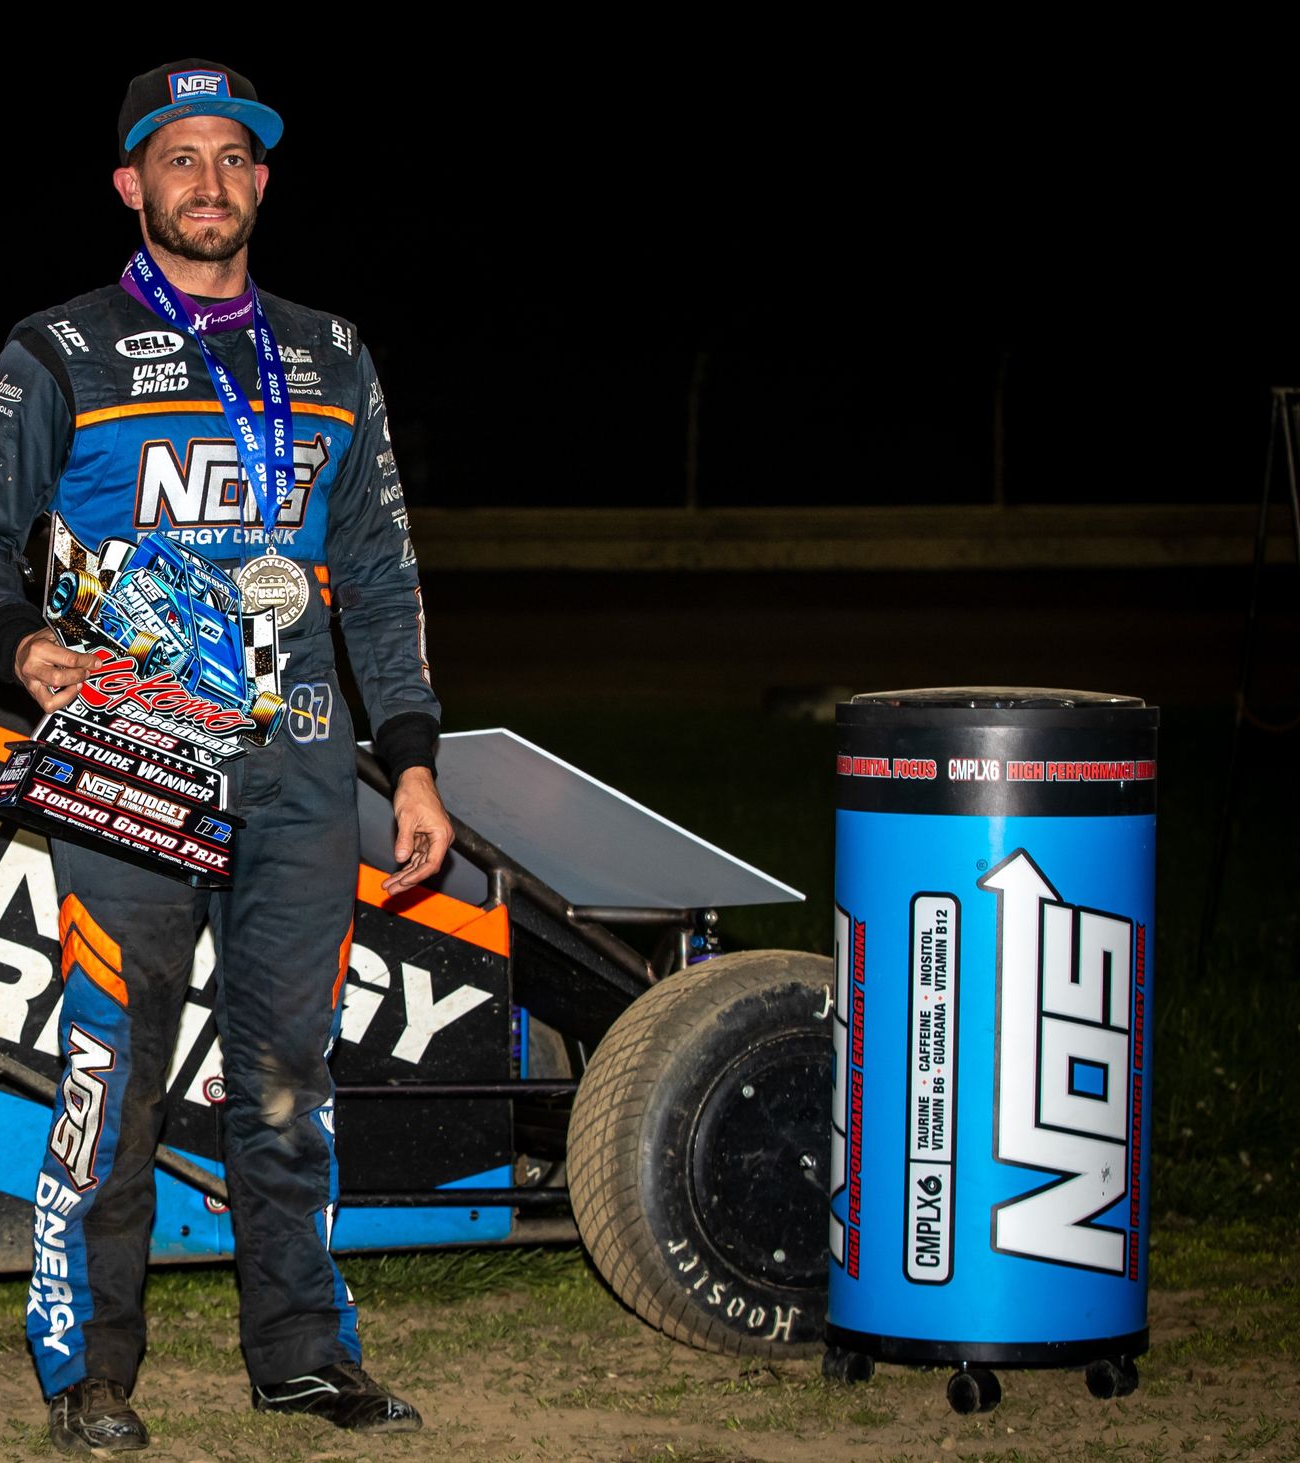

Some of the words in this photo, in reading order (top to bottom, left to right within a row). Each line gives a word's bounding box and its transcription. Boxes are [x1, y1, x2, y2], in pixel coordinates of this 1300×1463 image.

[177, 75, 222, 93] NOS
[135, 252, 153, 282] 2025
[154, 287, 177, 320] USAC
[124, 335, 176, 352] BELL
[129, 347, 174, 357] HELMETS
[261, 328, 274, 362] USAC
[131, 376, 189, 397] SHIELD
[133, 362, 187, 382] ULTRA
[267, 371, 282, 404] 2025
[215, 365, 238, 402] USAC
[236, 416, 259, 452] 2025
[273, 418, 286, 457] USAC
[132, 570, 168, 603] NOS
[194, 568, 230, 594] KOKOMO
[244, 558, 300, 580] FEATURE
[258, 588, 286, 599] USAC
[109, 718, 180, 750] 2025
[288, 682, 334, 745] 87
[0, 767, 29, 782] MIDGET
[78, 772, 126, 801] NOS
[853, 757, 892, 778] MENTAL
[893, 758, 938, 780] FOCUS
[948, 758, 1000, 780] CMPLX6
[1007, 760, 1045, 782] HIGH
[1046, 760, 1135, 782] PERFORMANCE
[28, 783, 110, 823] KOKOMO
[112, 816, 178, 850] GRAND
[178, 840, 229, 869] PRIX
[121, 787, 191, 820] MIDGET
[936, 909, 948, 935] B12
[854, 917, 866, 984] DRINK
[921, 928, 933, 986] INOSITOL
[935, 939, 947, 991] VITAMIN
[1136, 920, 1146, 982] DRINK
[852, 984, 865, 1067] ENERGY
[919, 1010, 931, 1072] CAFFEINE
[934, 1003, 946, 1065] GUARANA
[1134, 984, 1144, 1070] ENERGY
[933, 1077, 945, 1094] B6
[982, 853, 1132, 1272] NOS
[52, 1026, 114, 1189] NOS
[917, 1096, 930, 1150] TAURINE
[932, 1099, 944, 1150] VITAMIN
[849, 1068, 863, 1225] PERFORMANCE
[1130, 1072, 1142, 1229] PERFORMANCE
[915, 1175, 942, 1267] CMPLX6
[42, 1185, 82, 1356] ENERGY
[848, 1225, 860, 1280] HIGH
[1129, 1229, 1138, 1281] HIGH
